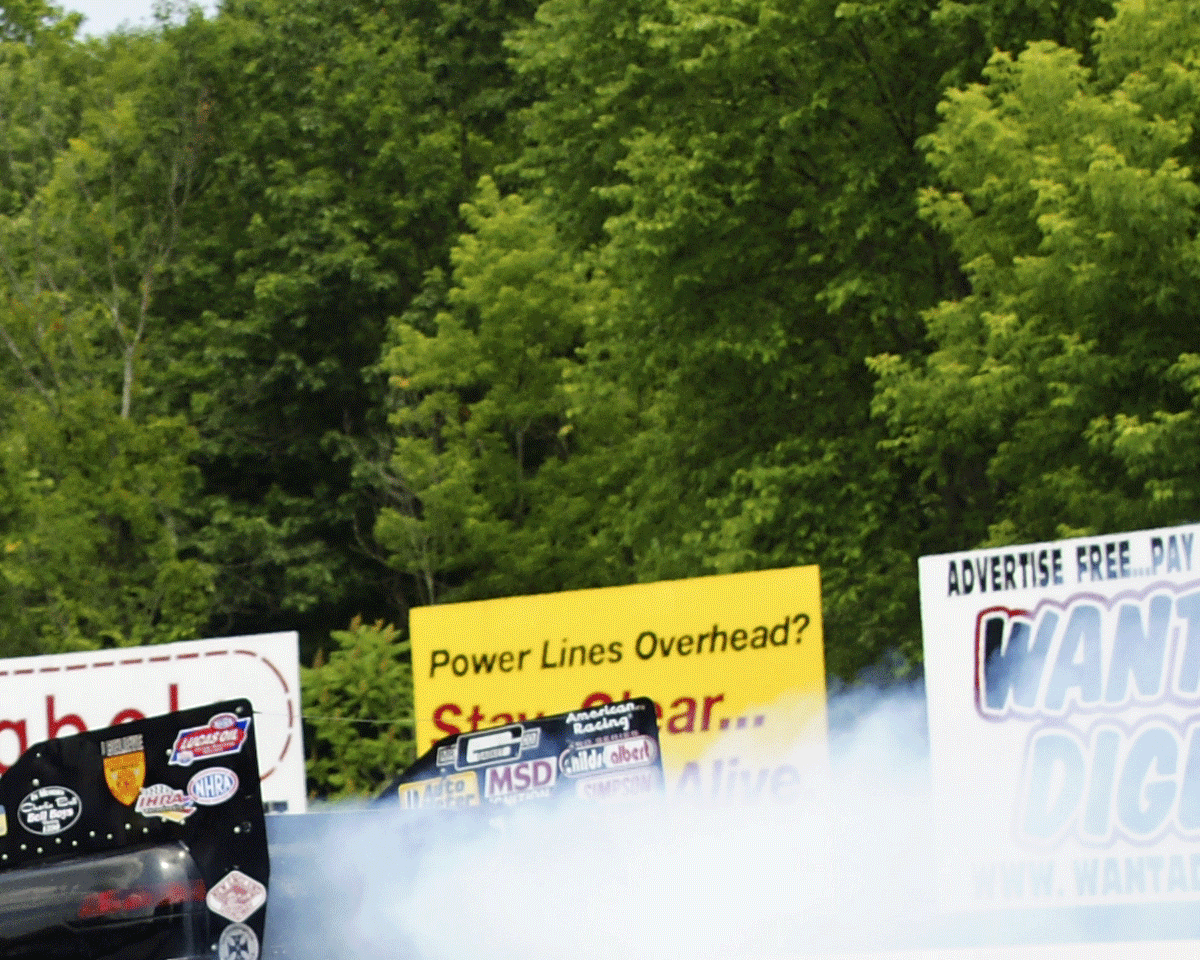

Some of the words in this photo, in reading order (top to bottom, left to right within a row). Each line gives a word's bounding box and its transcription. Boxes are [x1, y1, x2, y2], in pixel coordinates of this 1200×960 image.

[948, 549, 1063, 597] ADVERTISE
[429, 649, 532, 678] Power
[541, 638, 623, 670] Lines
[634, 612, 811, 661] Overhead?
[566, 702, 635, 724] American
[573, 716, 630, 735] Racing
[192, 771, 235, 798] NHRA
[488, 761, 552, 794] MSD
[675, 757, 801, 804] Alive
